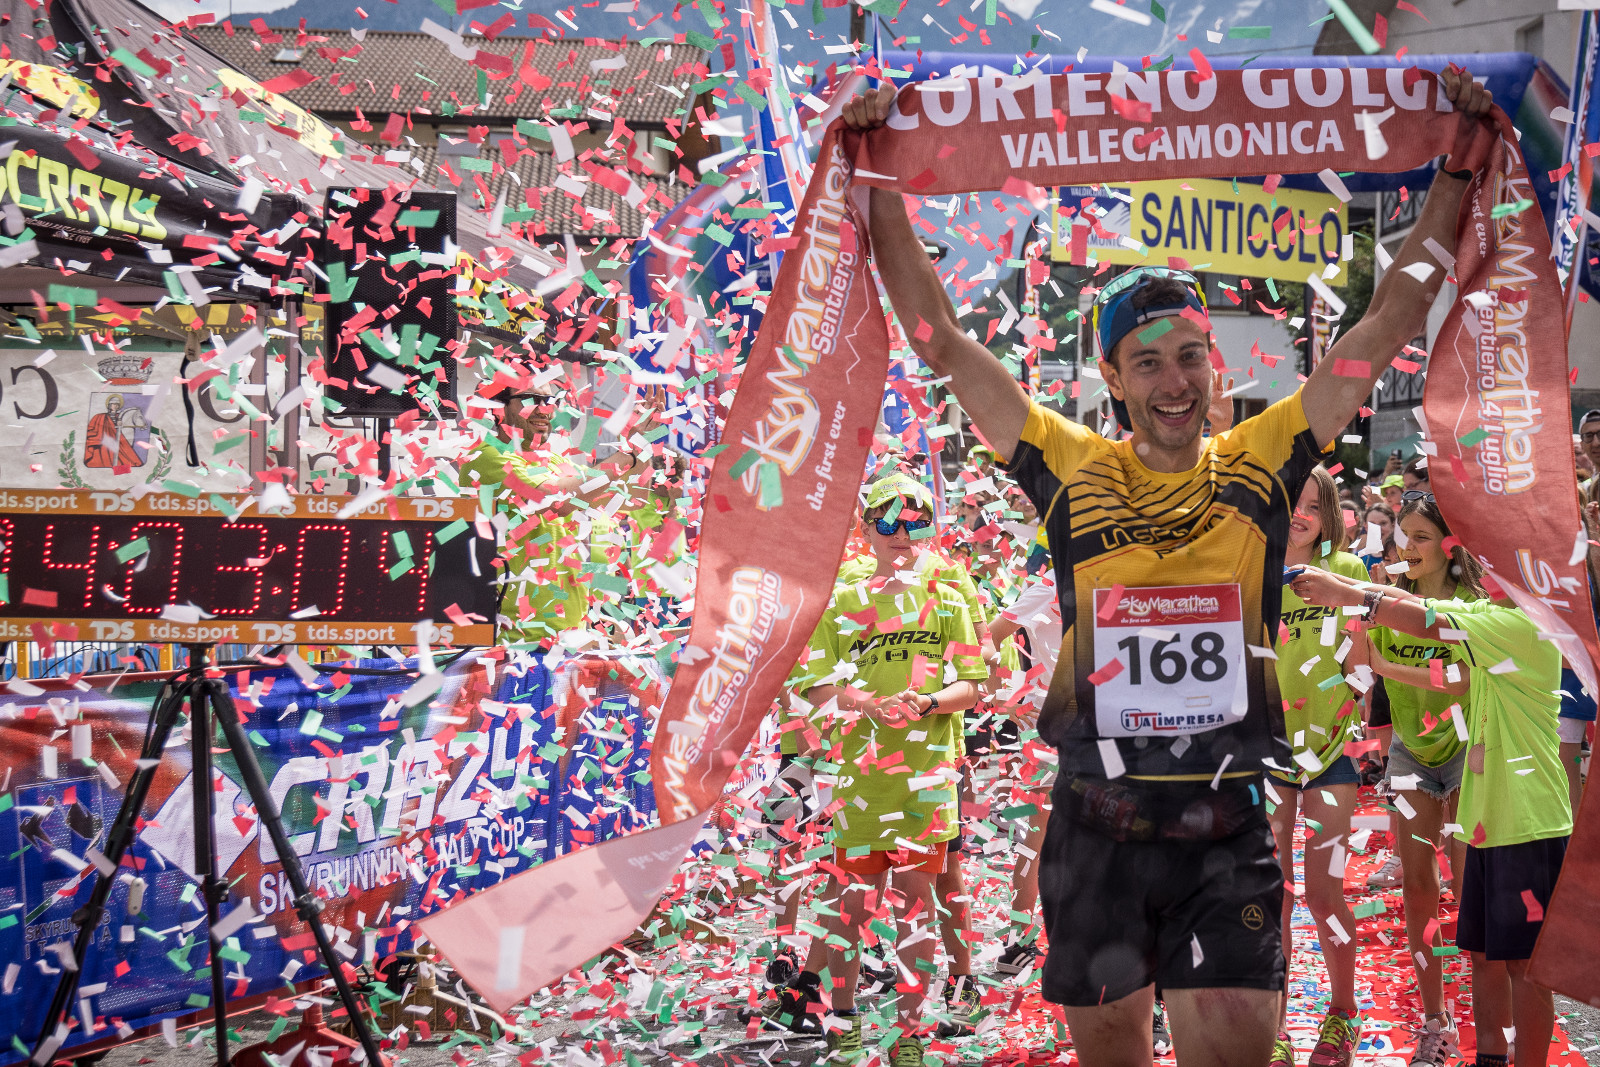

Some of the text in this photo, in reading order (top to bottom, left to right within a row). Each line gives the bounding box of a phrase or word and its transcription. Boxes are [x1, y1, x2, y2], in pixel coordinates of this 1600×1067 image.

[1001, 119, 1345, 168] VALLECAMONICA
[6, 149, 168, 241] CRAZY
[1141, 192, 1342, 266] SANTICOLO
[806, 400, 847, 511] the first ever
[89, 493, 135, 512] TDS
[411, 499, 455, 518] TDS
[89, 621, 135, 640] TDS
[149, 624, 239, 645] tds.sport
[251, 623, 297, 642] TDS
[308, 625, 396, 647] tds.sport
[867, 630, 941, 648] CRAZY
[1117, 631, 1228, 685] 168
[259, 728, 531, 865] CRAZY
[487, 815, 525, 857] CUP
